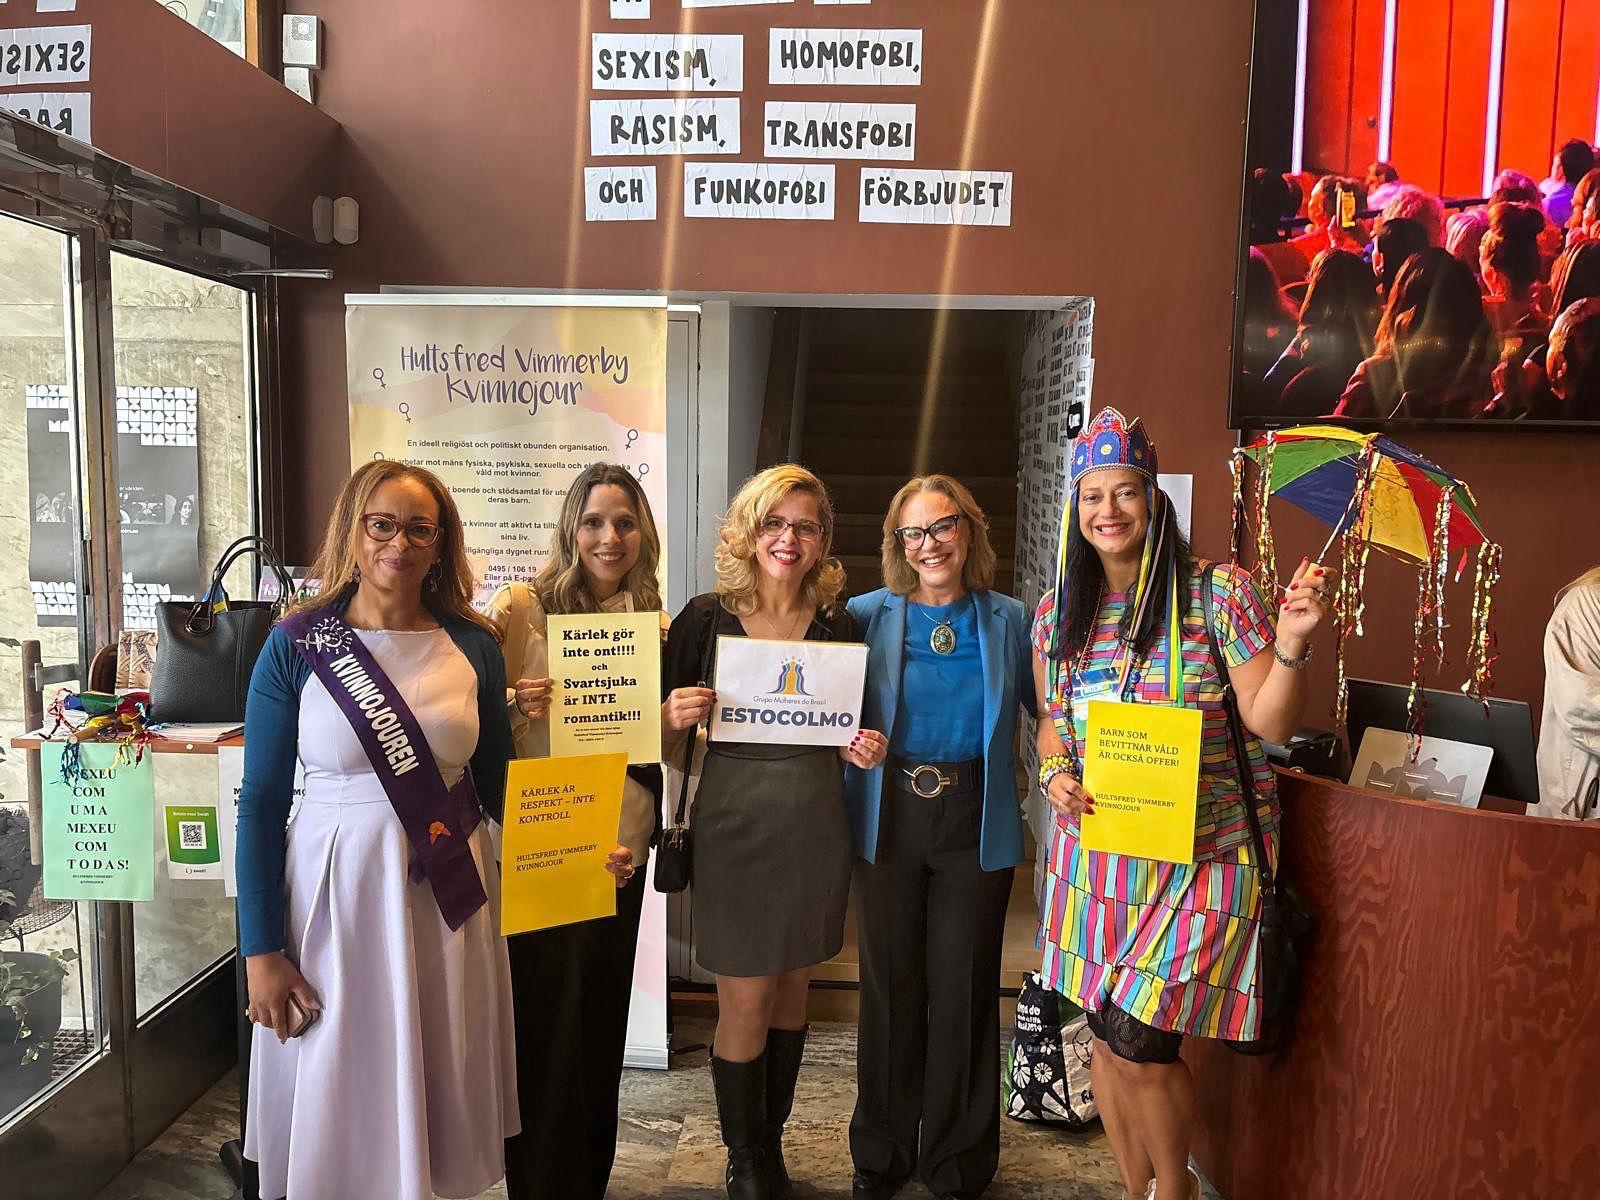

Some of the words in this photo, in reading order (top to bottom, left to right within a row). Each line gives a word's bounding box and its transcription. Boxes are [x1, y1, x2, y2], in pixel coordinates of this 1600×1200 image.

[597, 48, 717, 87] SEXISM,
[780, 39, 920, 73] HOMOFOBI,
[610, 114, 726, 148] RASISM,
[766, 119, 912, 148] TRANSFOBI
[599, 178, 643, 204] OCH
[694, 177, 826, 205] FUNKOFOBI
[864, 176, 1004, 207] FÖRBJUDET
[401, 344, 505, 373] Hultsfred
[515, 346, 629, 385] Vimmerby
[446, 372, 584, 416] Kvinnojour
[441, 440, 473, 449] religiöst
[490, 442, 521, 450] politiskt
[523, 442, 557, 450] obunden
[560, 443, 610, 452] organisation.
[465, 460, 494, 468] fysiska,
[496, 461, 532, 469] psykiska,
[452, 486, 480, 494] boende
[498, 487, 540, 496] stödsamtal
[542, 488, 553, 496] för
[469, 520, 497, 528] kvinnor
[511, 521, 532, 529] aktivt
[500, 533, 517, 541] sina
[505, 548, 532, 556] dygnet
[503, 574, 512, 582] på
[562, 628, 609, 641] Kärlek
[613, 628, 635, 641] gör
[563, 646, 590, 657] inte
[594, 645, 635, 656] ont!!!!
[591, 663, 608, 671] och
[563, 676, 637, 690] Svartsjuka
[563, 696, 579, 706] är
[582, 693, 617, 705] INTE
[753, 695, 773, 705] Grupo
[774, 696, 800, 705] Mulheres
[801, 697, 810, 705] do
[329, 652, 420, 777] KVINNOJOUREN
[563, 710, 641, 724] romantik!!!
[721, 707, 854, 728] ESTOCOLMO
[1100, 728, 1125, 737] BARN
[1127, 730, 1148, 740] SOM
[1099, 739, 1152, 753] BEVITTNAR
[1154, 744, 1179, 756] VÅLD
[1113, 752, 1144, 763] OCKSÅ
[1146, 756, 1179, 767] OFFER!
[73, 787, 105, 797] COM
[520, 798, 563, 810] RESPEKT
[572, 795, 596, 804] INTE
[1095, 793, 1136, 803] HULTSFRED
[1137, 798, 1176, 808] VIMMERBY
[1095, 801, 1141, 812] KVINNOJOUR
[518, 811, 571, 824] KONTROLL
[67, 823, 117, 834] MEXEU
[75, 841, 107, 851] COM
[516, 850, 558, 862] HULTSFRED
[559, 844, 597, 855] VIMMERBY
[516, 858, 563, 872] KVINNOJOUR
